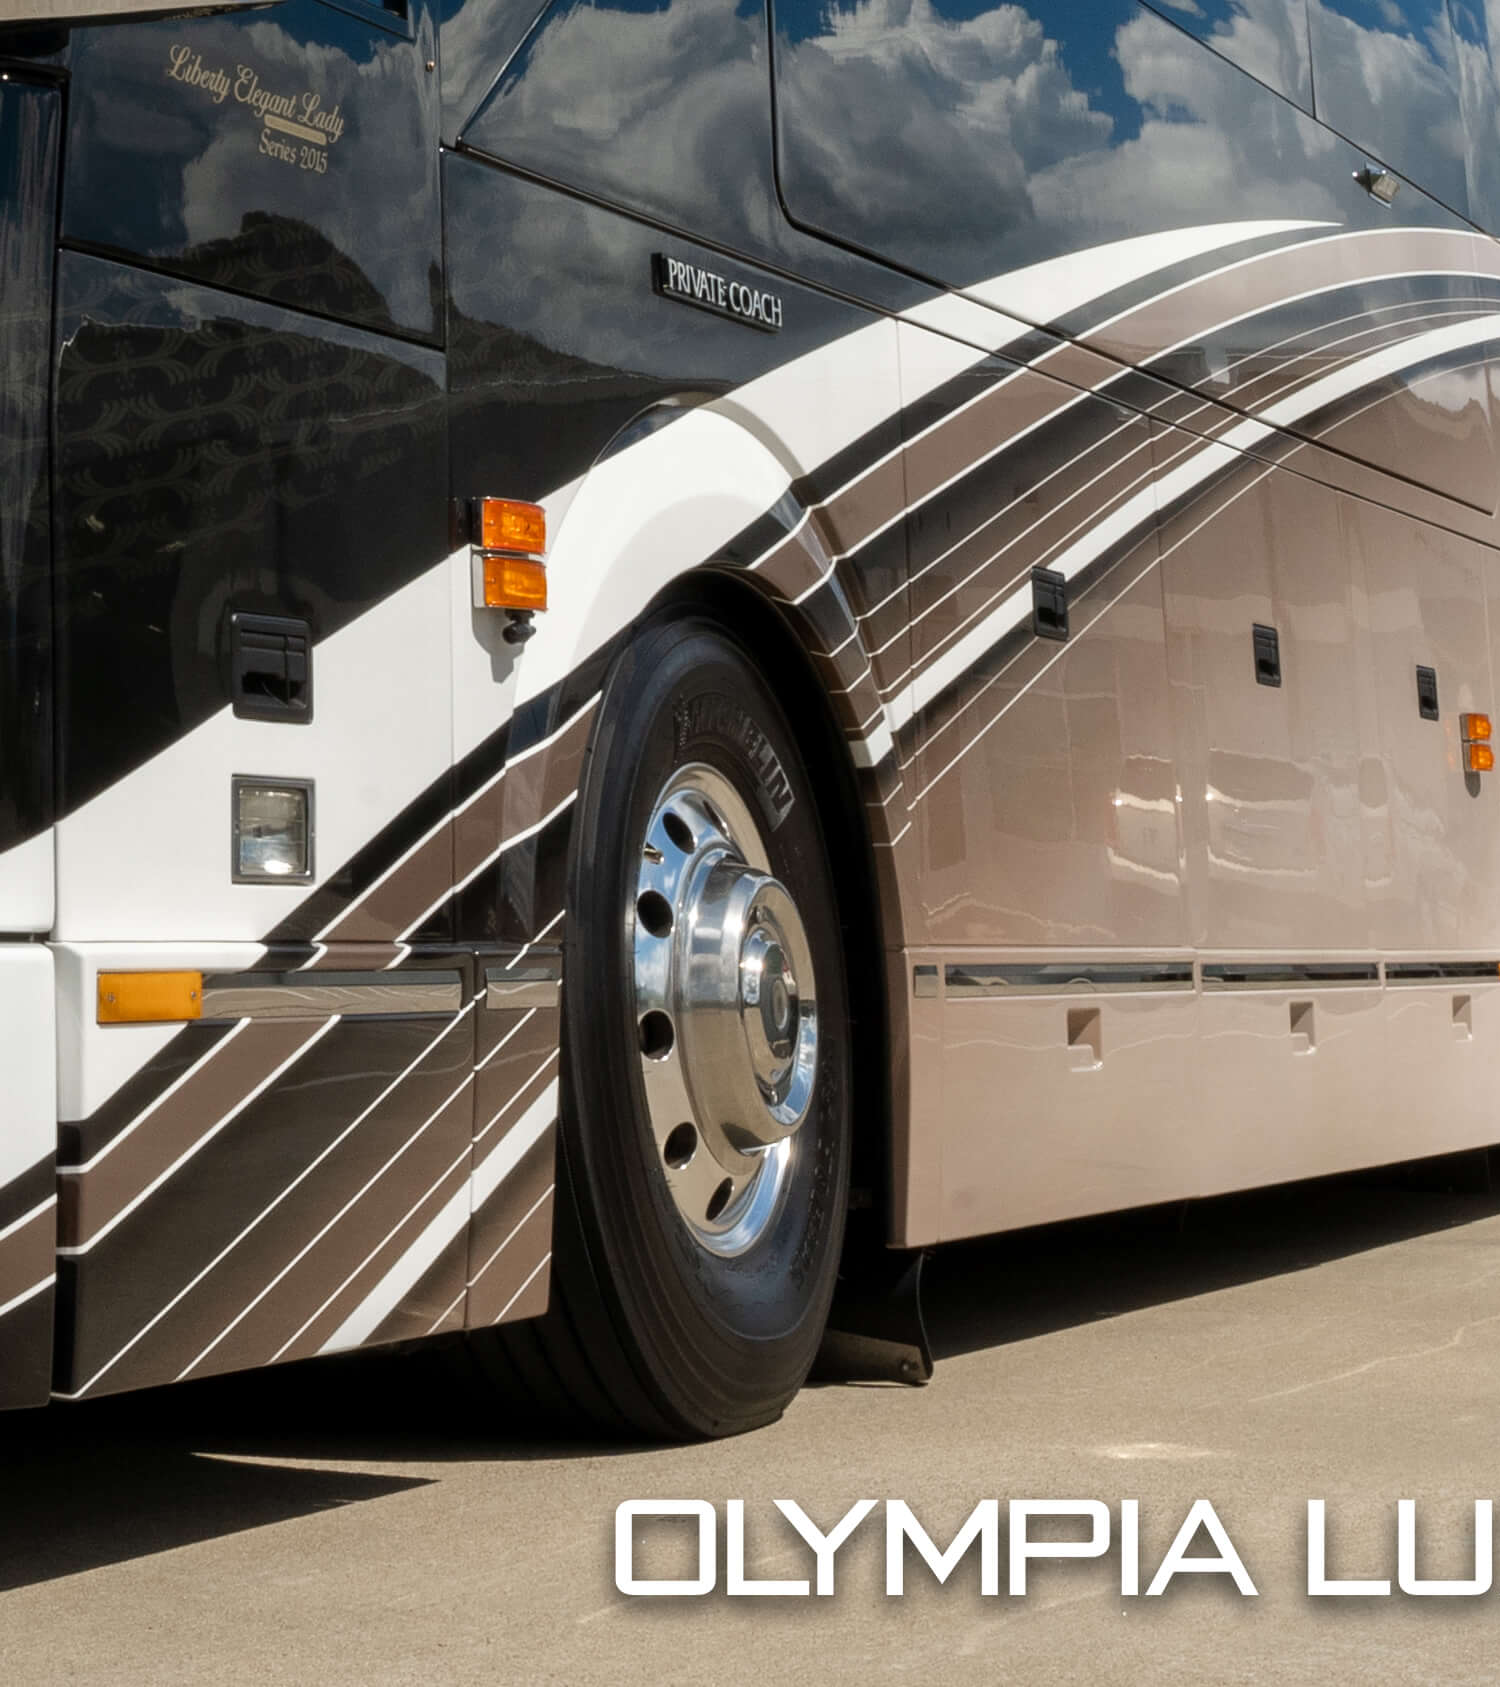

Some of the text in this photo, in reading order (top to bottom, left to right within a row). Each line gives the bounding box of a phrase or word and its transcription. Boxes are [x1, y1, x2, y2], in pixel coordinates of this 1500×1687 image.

[166, 44, 344, 143] Liberty Elegant Lady
[259, 128, 329, 174] Series 2015
[667, 257, 783, 328] PRIVATE COACH
